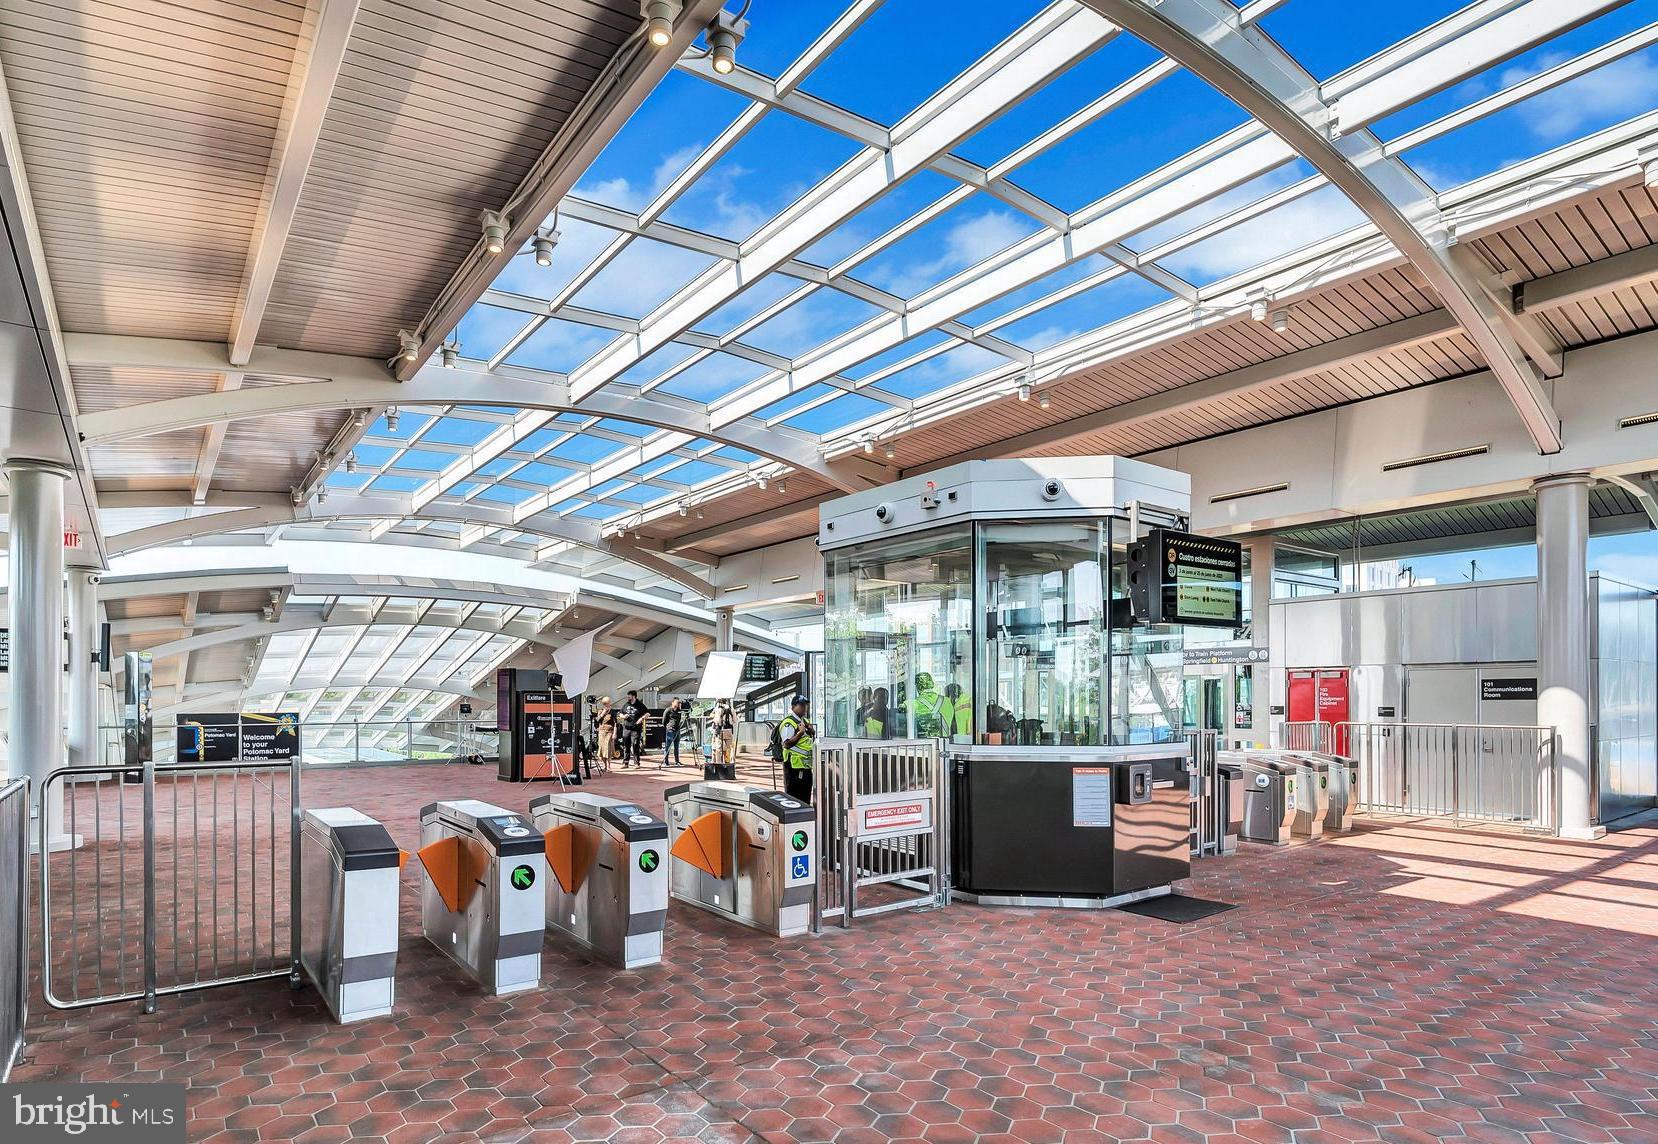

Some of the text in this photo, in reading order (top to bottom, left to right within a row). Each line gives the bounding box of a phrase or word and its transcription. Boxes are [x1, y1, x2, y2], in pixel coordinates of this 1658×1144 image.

[64, 533, 78, 547] XIT
[1179, 552, 1194, 561] Cuatro
[1195, 556, 1217, 564] estaciones
[1218, 656, 1249, 664] Huntington
[867, 809, 896, 817] EMERGENCY
